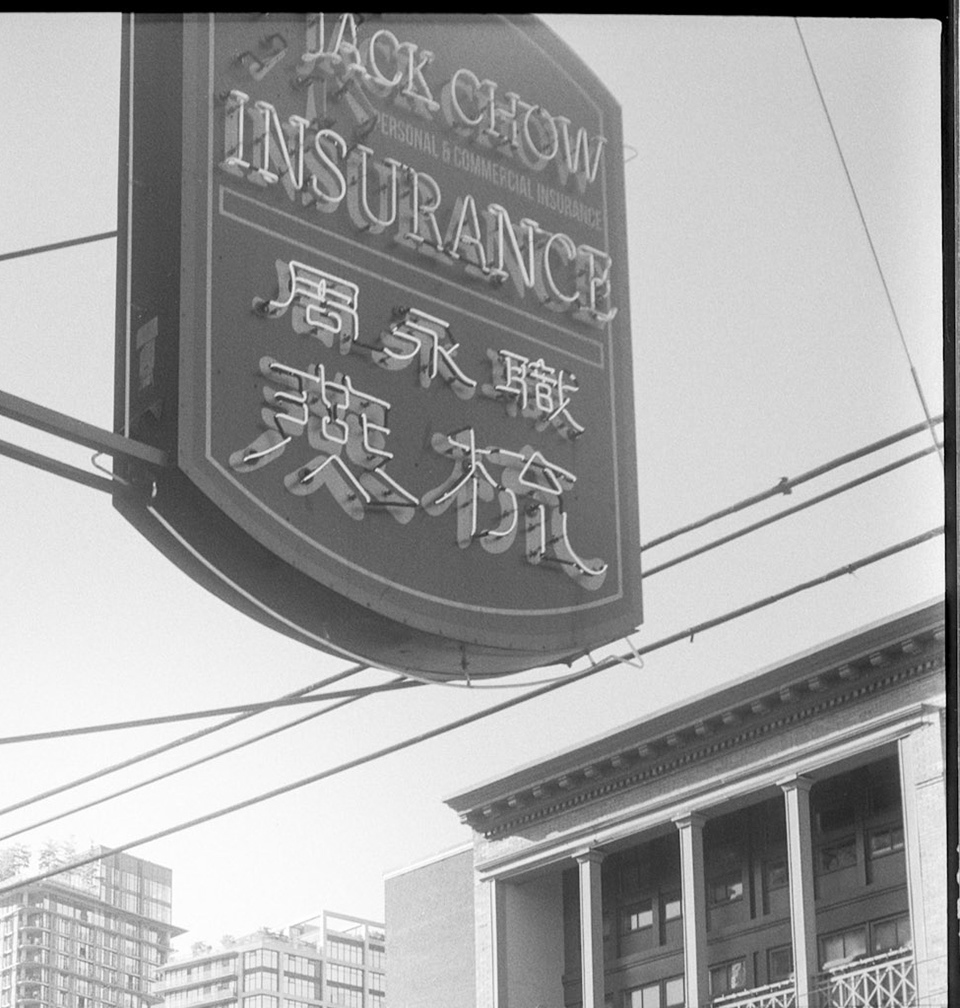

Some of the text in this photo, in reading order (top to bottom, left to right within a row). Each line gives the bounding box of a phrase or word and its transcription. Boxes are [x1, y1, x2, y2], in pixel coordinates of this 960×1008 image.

[375, 112, 604, 231] PERSONAL & COMMERCIAL INSURANCE
[447, 68, 608, 187] CHOW
[221, 89, 618, 325] INSURANCE
